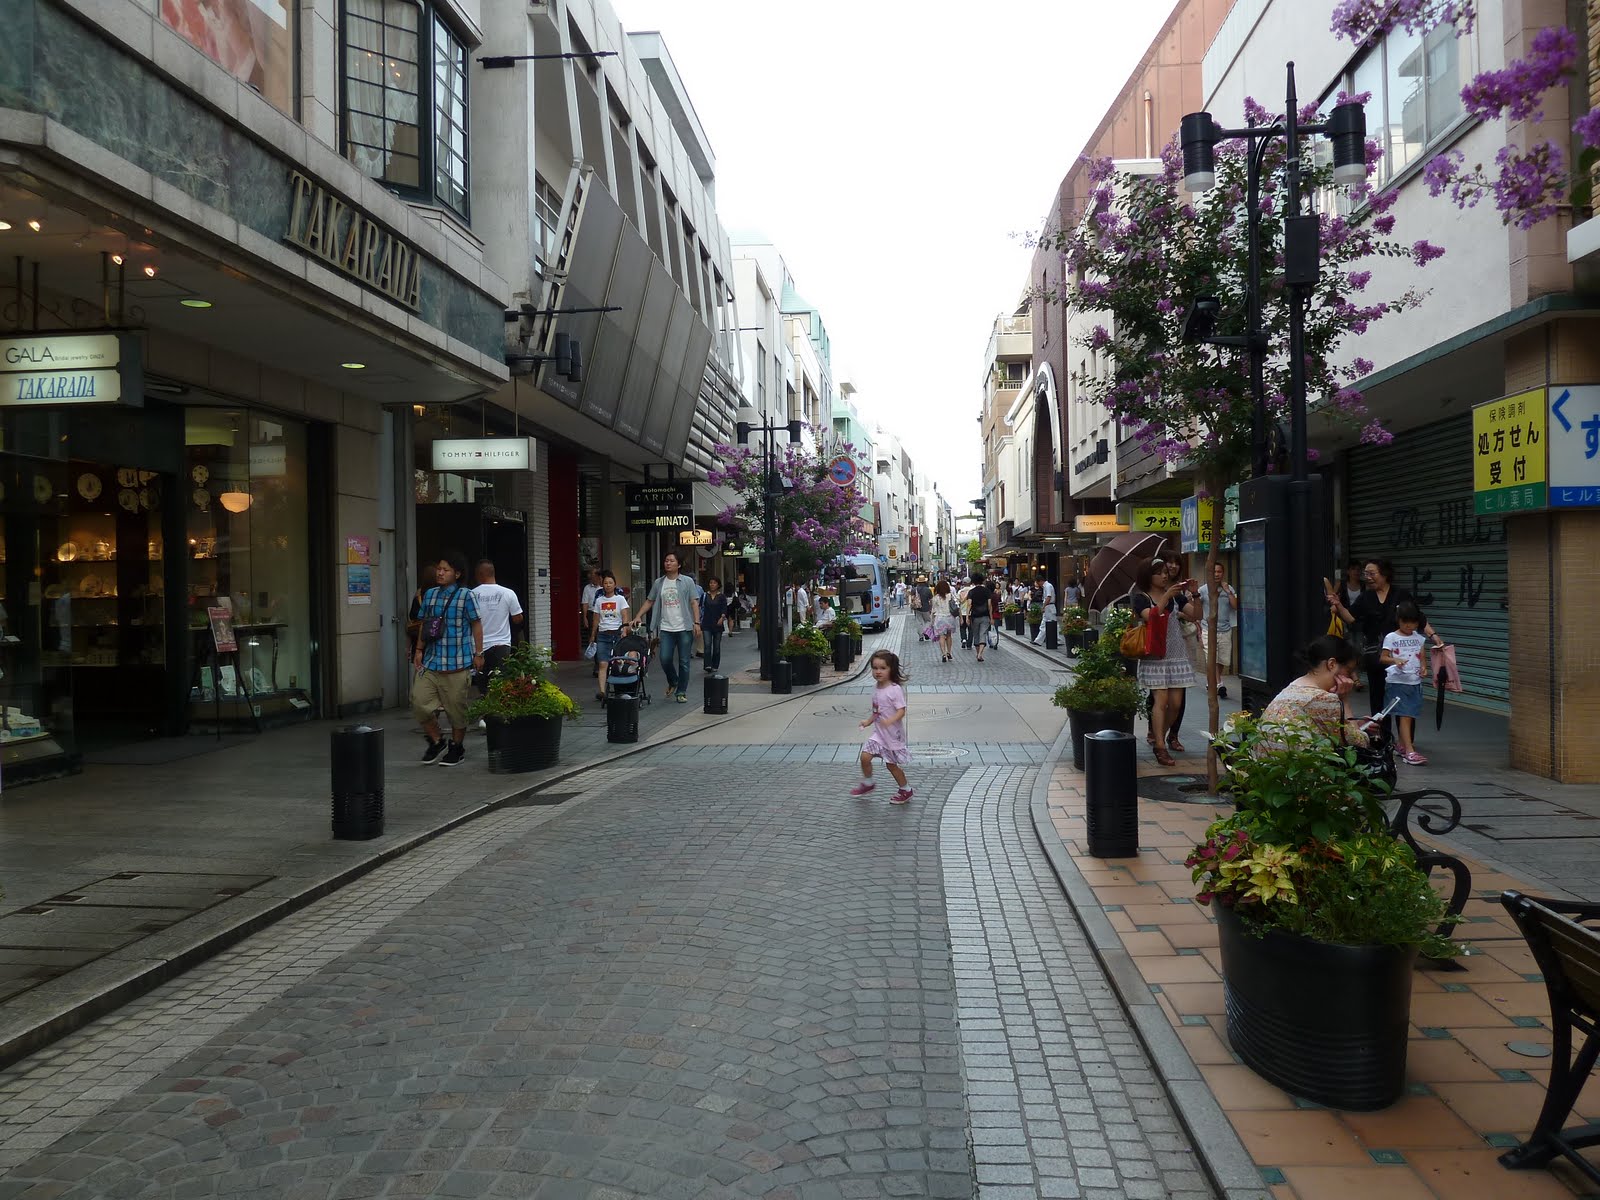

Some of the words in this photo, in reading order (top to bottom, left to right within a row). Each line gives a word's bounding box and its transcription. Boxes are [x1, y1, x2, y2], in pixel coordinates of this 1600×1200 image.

[283, 169, 421, 313] TAKARADA
[5, 347, 55, 364] GALA
[17, 375, 97, 400] TAKARADA
[1489, 400, 1526, 423] 保険調剤
[1478, 421, 1540, 456] 処方せん
[1490, 455, 1526, 486] 受付
[1484, 488, 1534, 510] ヒル薬局
[1562, 488, 1600, 503] ヒル
[655, 515, 689, 526] MINATO
[1201, 520, 1212, 541] 受付
[681, 536, 691, 544] Le
[693, 536, 712, 544] Beau
